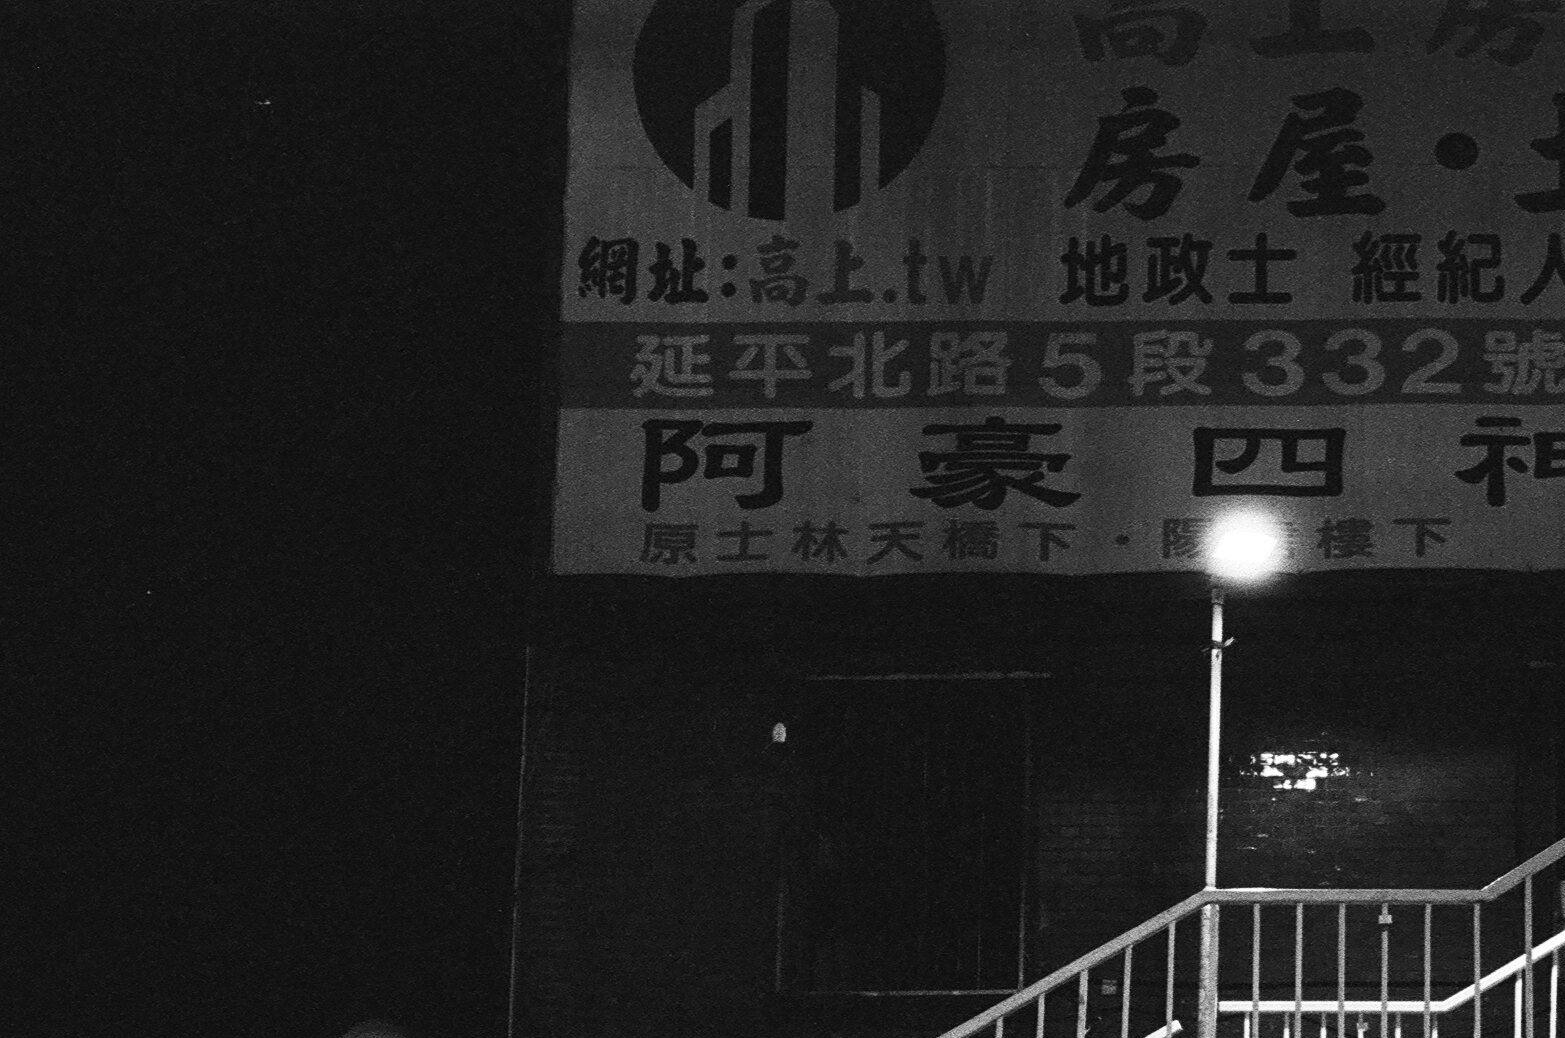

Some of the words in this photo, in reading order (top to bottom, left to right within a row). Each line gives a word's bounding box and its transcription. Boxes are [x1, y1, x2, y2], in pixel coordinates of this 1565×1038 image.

[1058, 232, 1299, 307] 地政士
[638, 517, 1452, 566] 原士林天橋下·陽樓下
